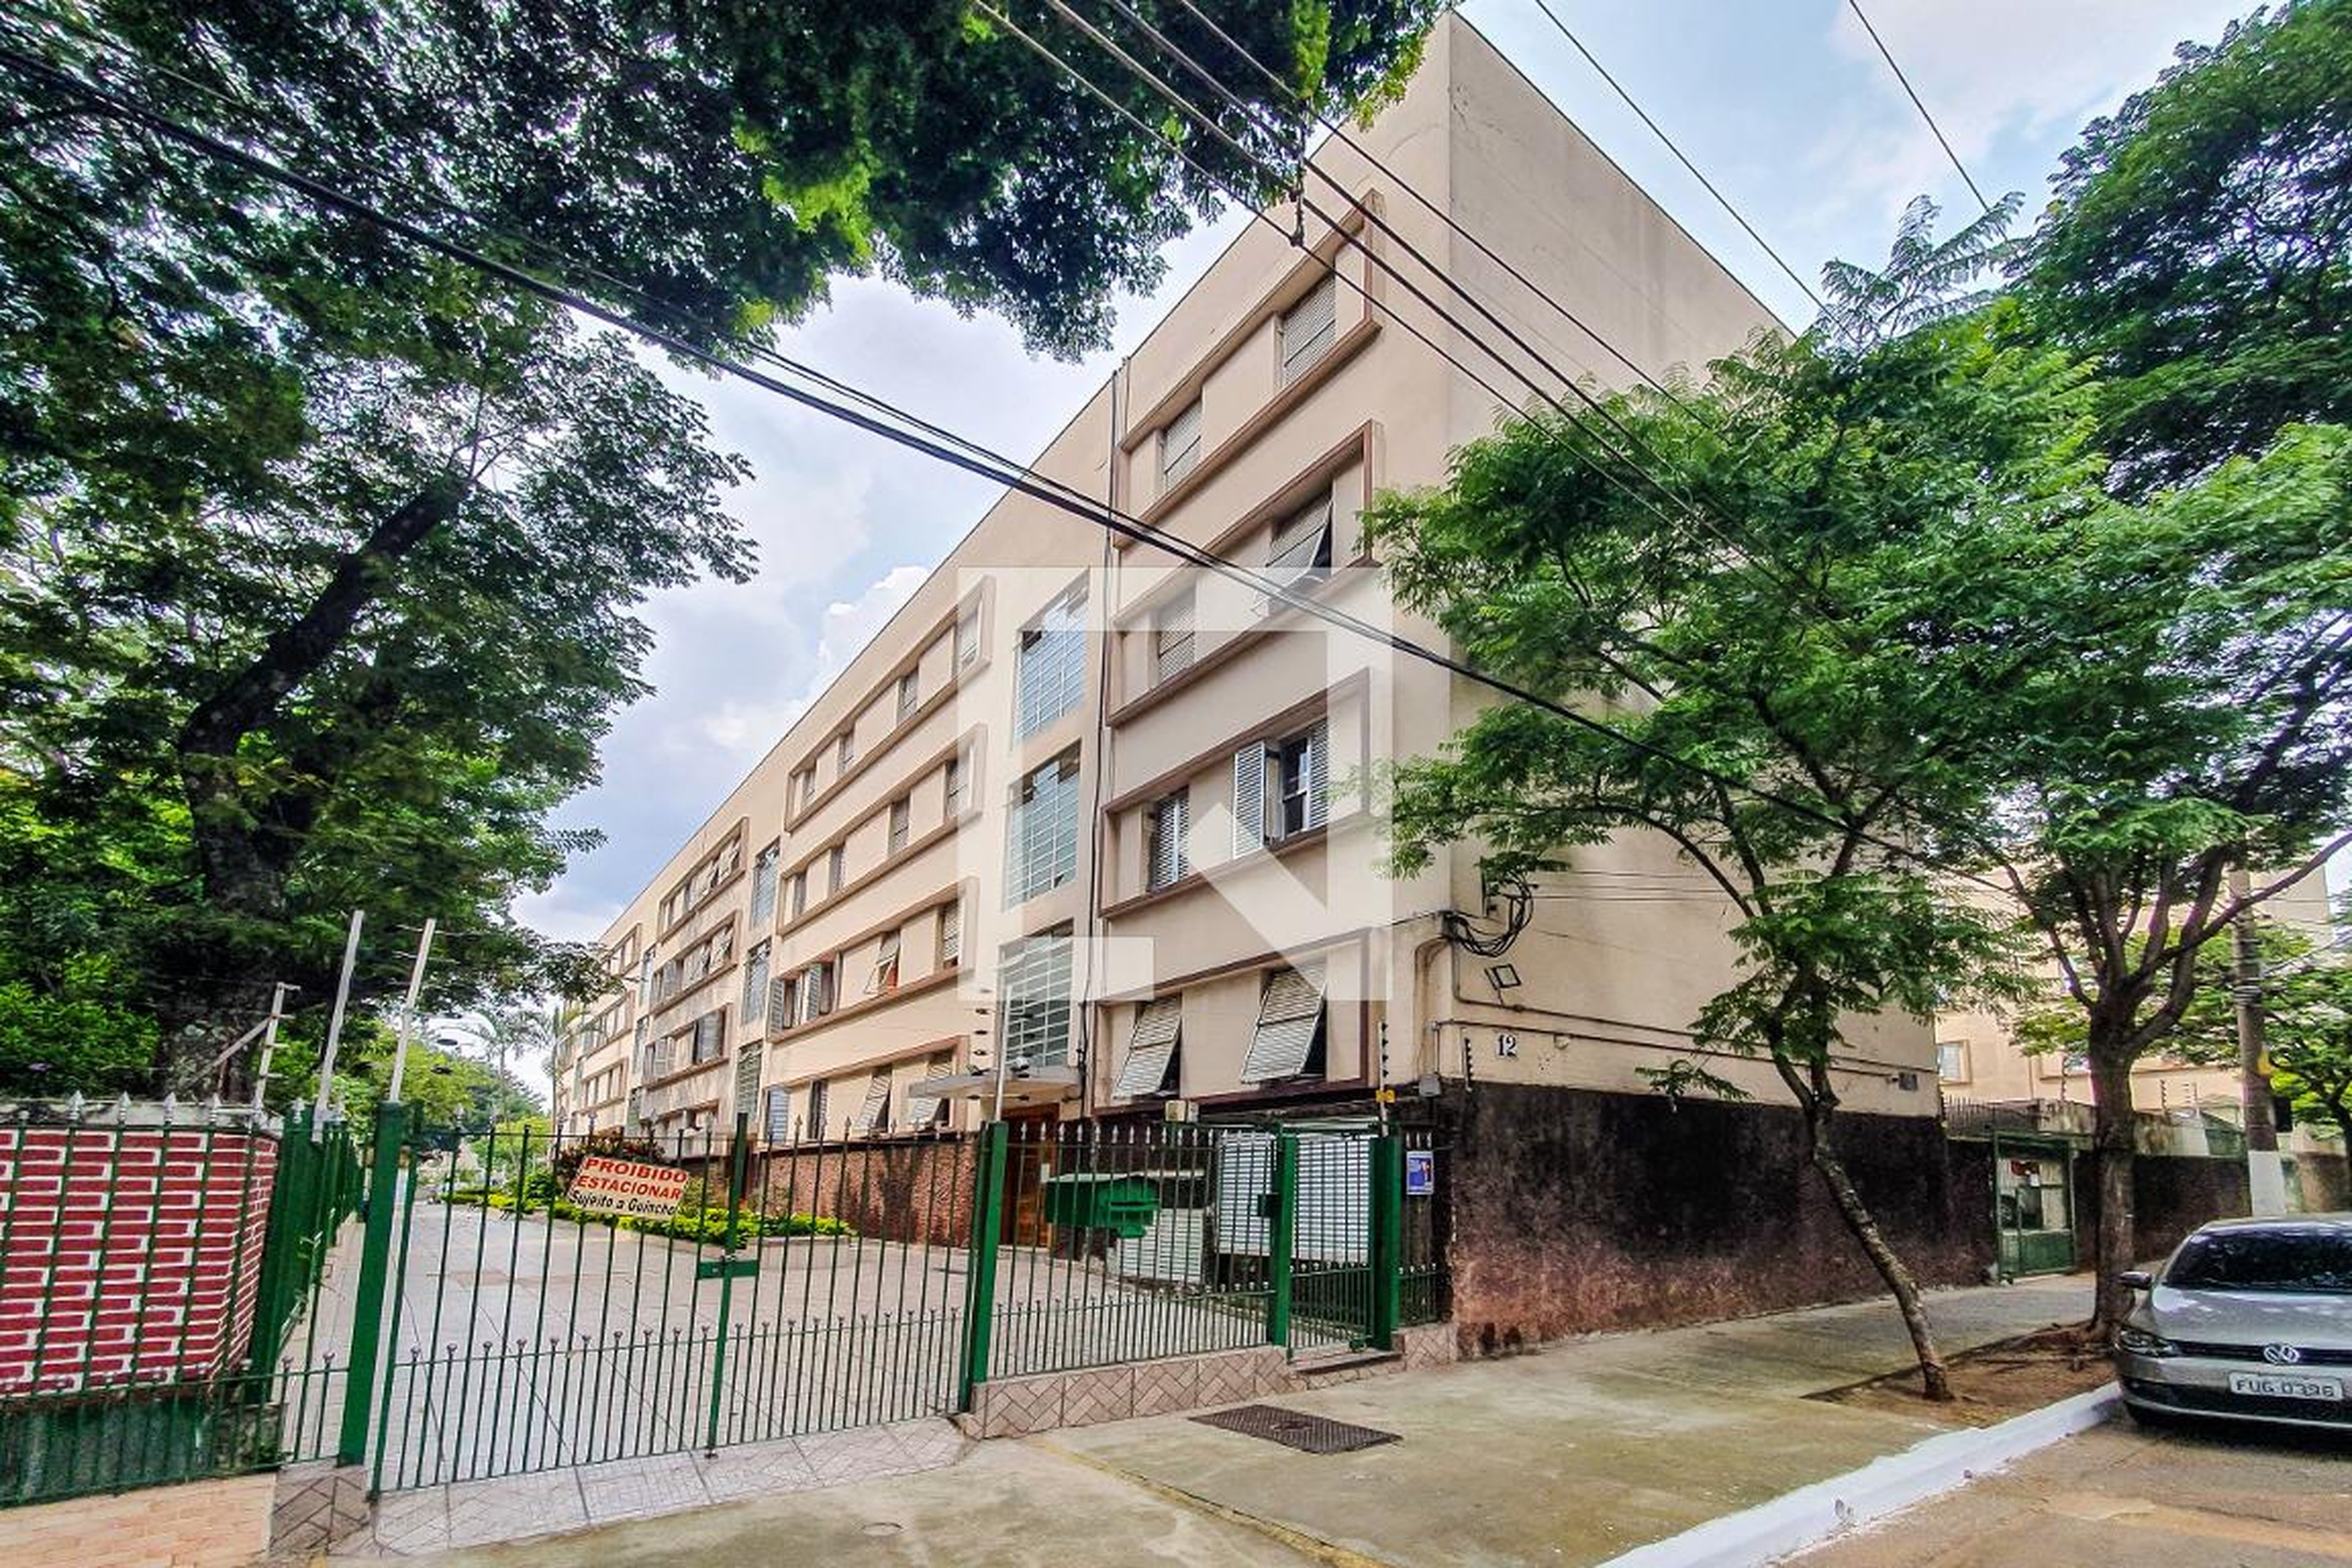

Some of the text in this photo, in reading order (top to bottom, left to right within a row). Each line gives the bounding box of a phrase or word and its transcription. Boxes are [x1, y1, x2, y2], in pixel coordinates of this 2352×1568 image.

[1498, 1035, 1517, 1058] 12
[584, 1158, 687, 1183] PROIBIDO
[577, 1175, 682, 1200] ESTACIONAR
[569, 1190, 674, 1216] Sujeito a Guincho
